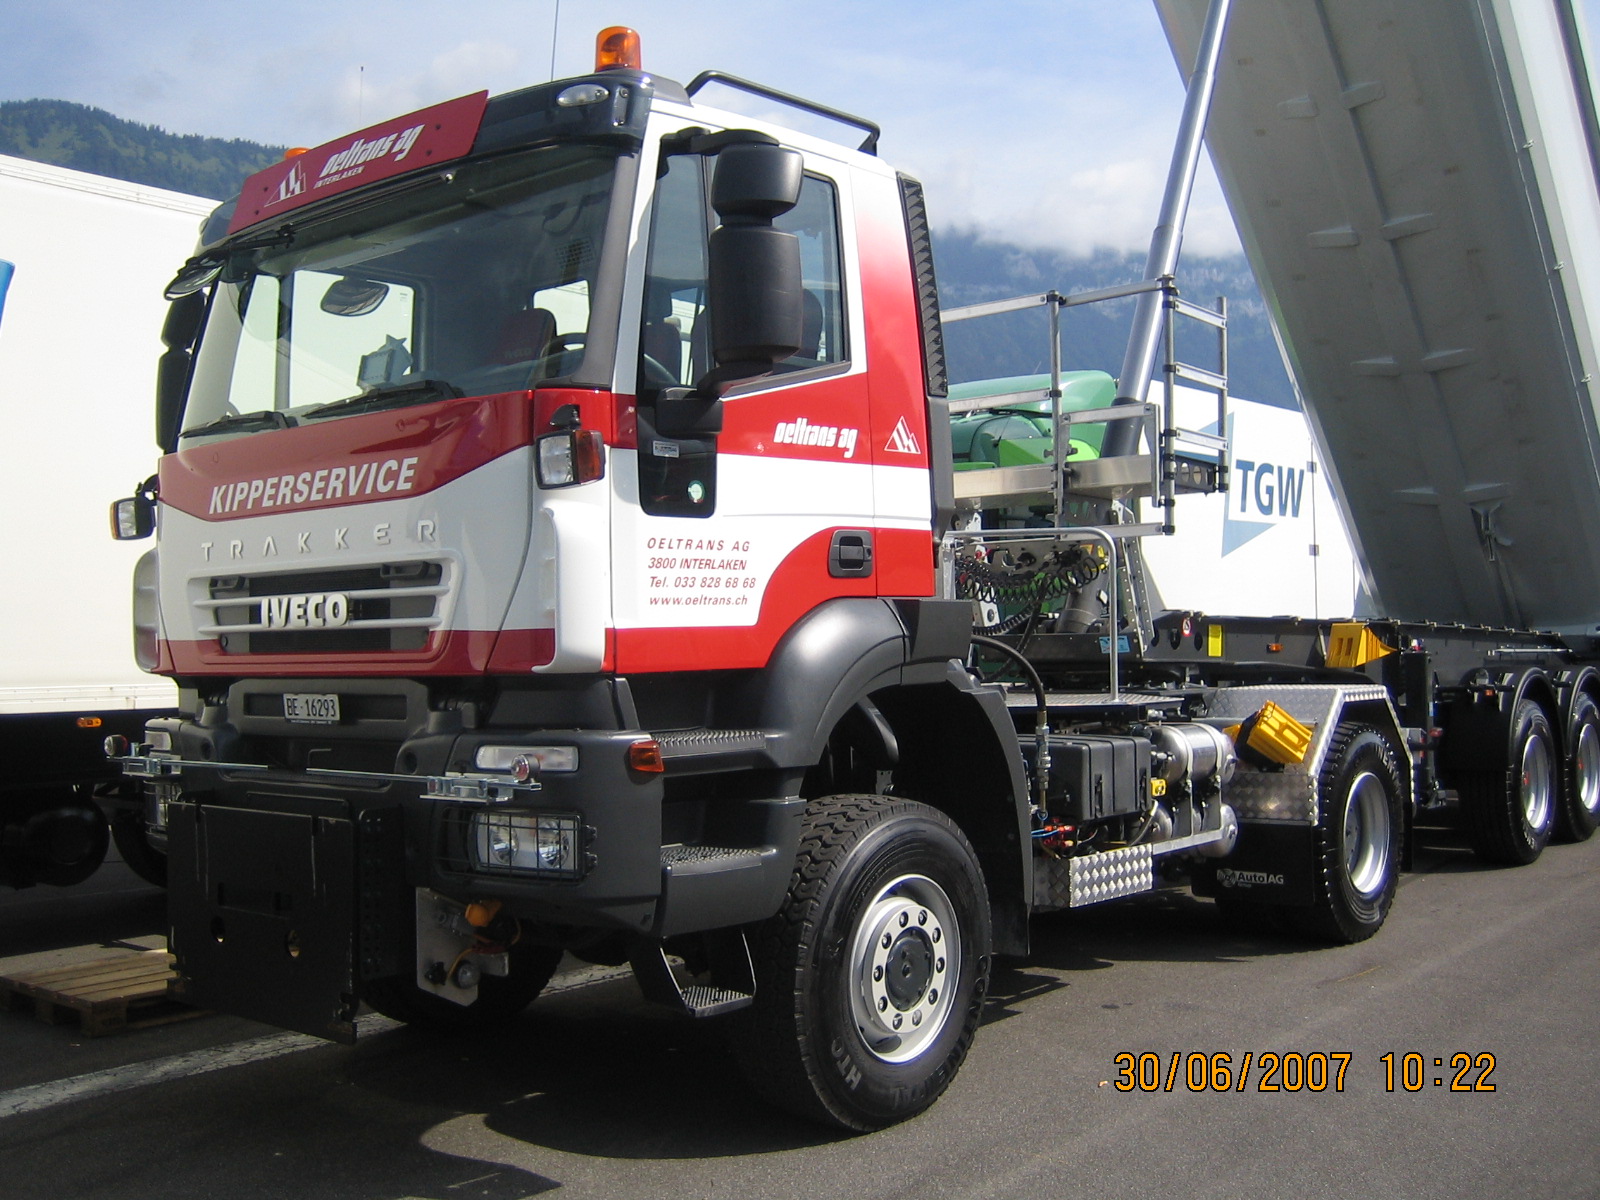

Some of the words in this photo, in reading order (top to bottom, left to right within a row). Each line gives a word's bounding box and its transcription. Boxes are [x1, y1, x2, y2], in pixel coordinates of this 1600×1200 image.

[319, 132, 398, 178] oeltrans
[391, 124, 425, 161] ag
[313, 166, 365, 189] INTERLAKEN
[773, 417, 838, 447] oeltrans
[837, 428, 858, 458] ag
[208, 457, 419, 515] KIPPERSERVICE
[1235, 459, 1305, 518] TGW
[201, 519, 436, 561] TRAKKER
[647, 537, 725, 551] OELTRANS
[731, 541, 750, 552] AG
[648, 557, 677, 569] 3800
[679, 558, 748, 570] INTERLAKEN
[649, 576, 669, 588] Tel.
[674, 576, 696, 588] 033
[700, 576, 721, 588] 828
[725, 577, 739, 588] 68
[742, 577, 757, 589] 68
[261, 592, 349, 628] IVECO
[649, 594, 748, 606] www.oeltrans.ch
[1237, 872, 1266, 883] Auto
[1268, 874, 1284, 884] AG
